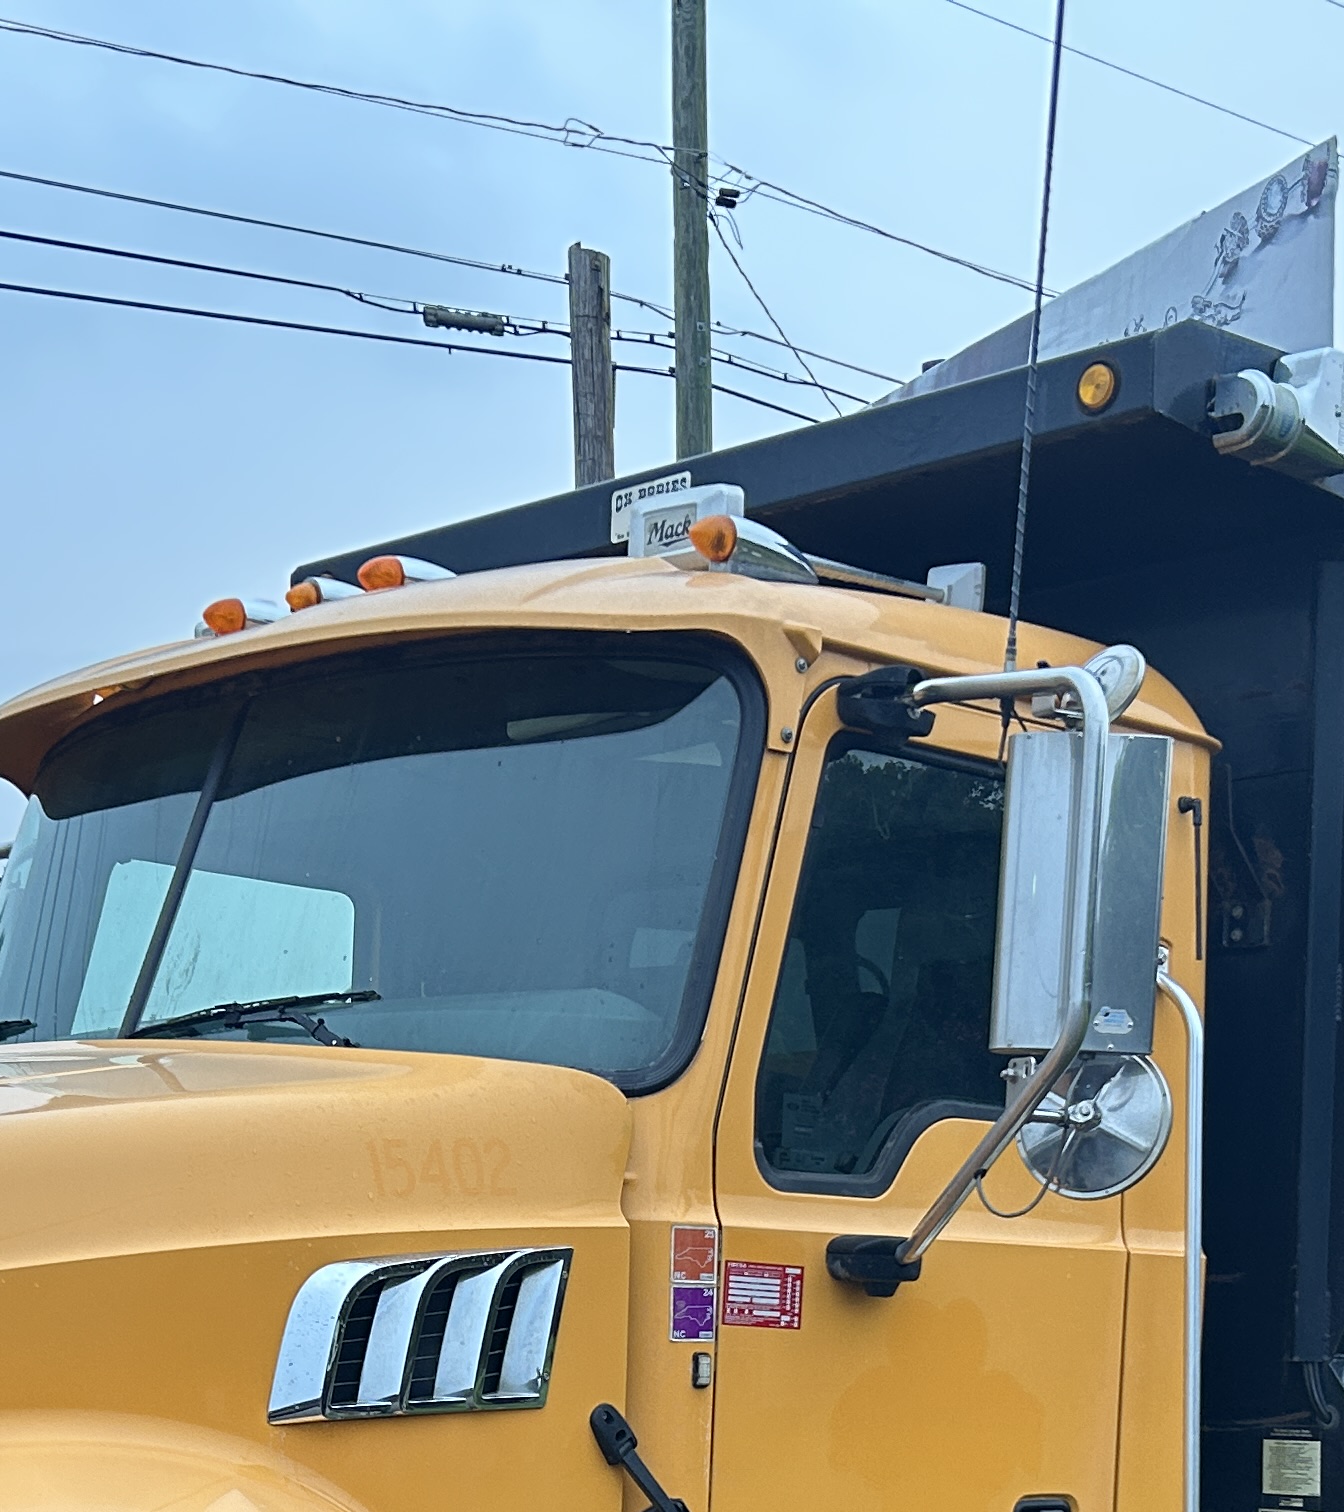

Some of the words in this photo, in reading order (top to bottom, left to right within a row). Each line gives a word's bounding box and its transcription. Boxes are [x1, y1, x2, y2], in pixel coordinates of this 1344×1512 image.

[646, 513, 692, 546] Mack
[674, 1271, 687, 1280] NC
[702, 1288, 714, 1297] 24
[673, 1330, 687, 1338] NC
